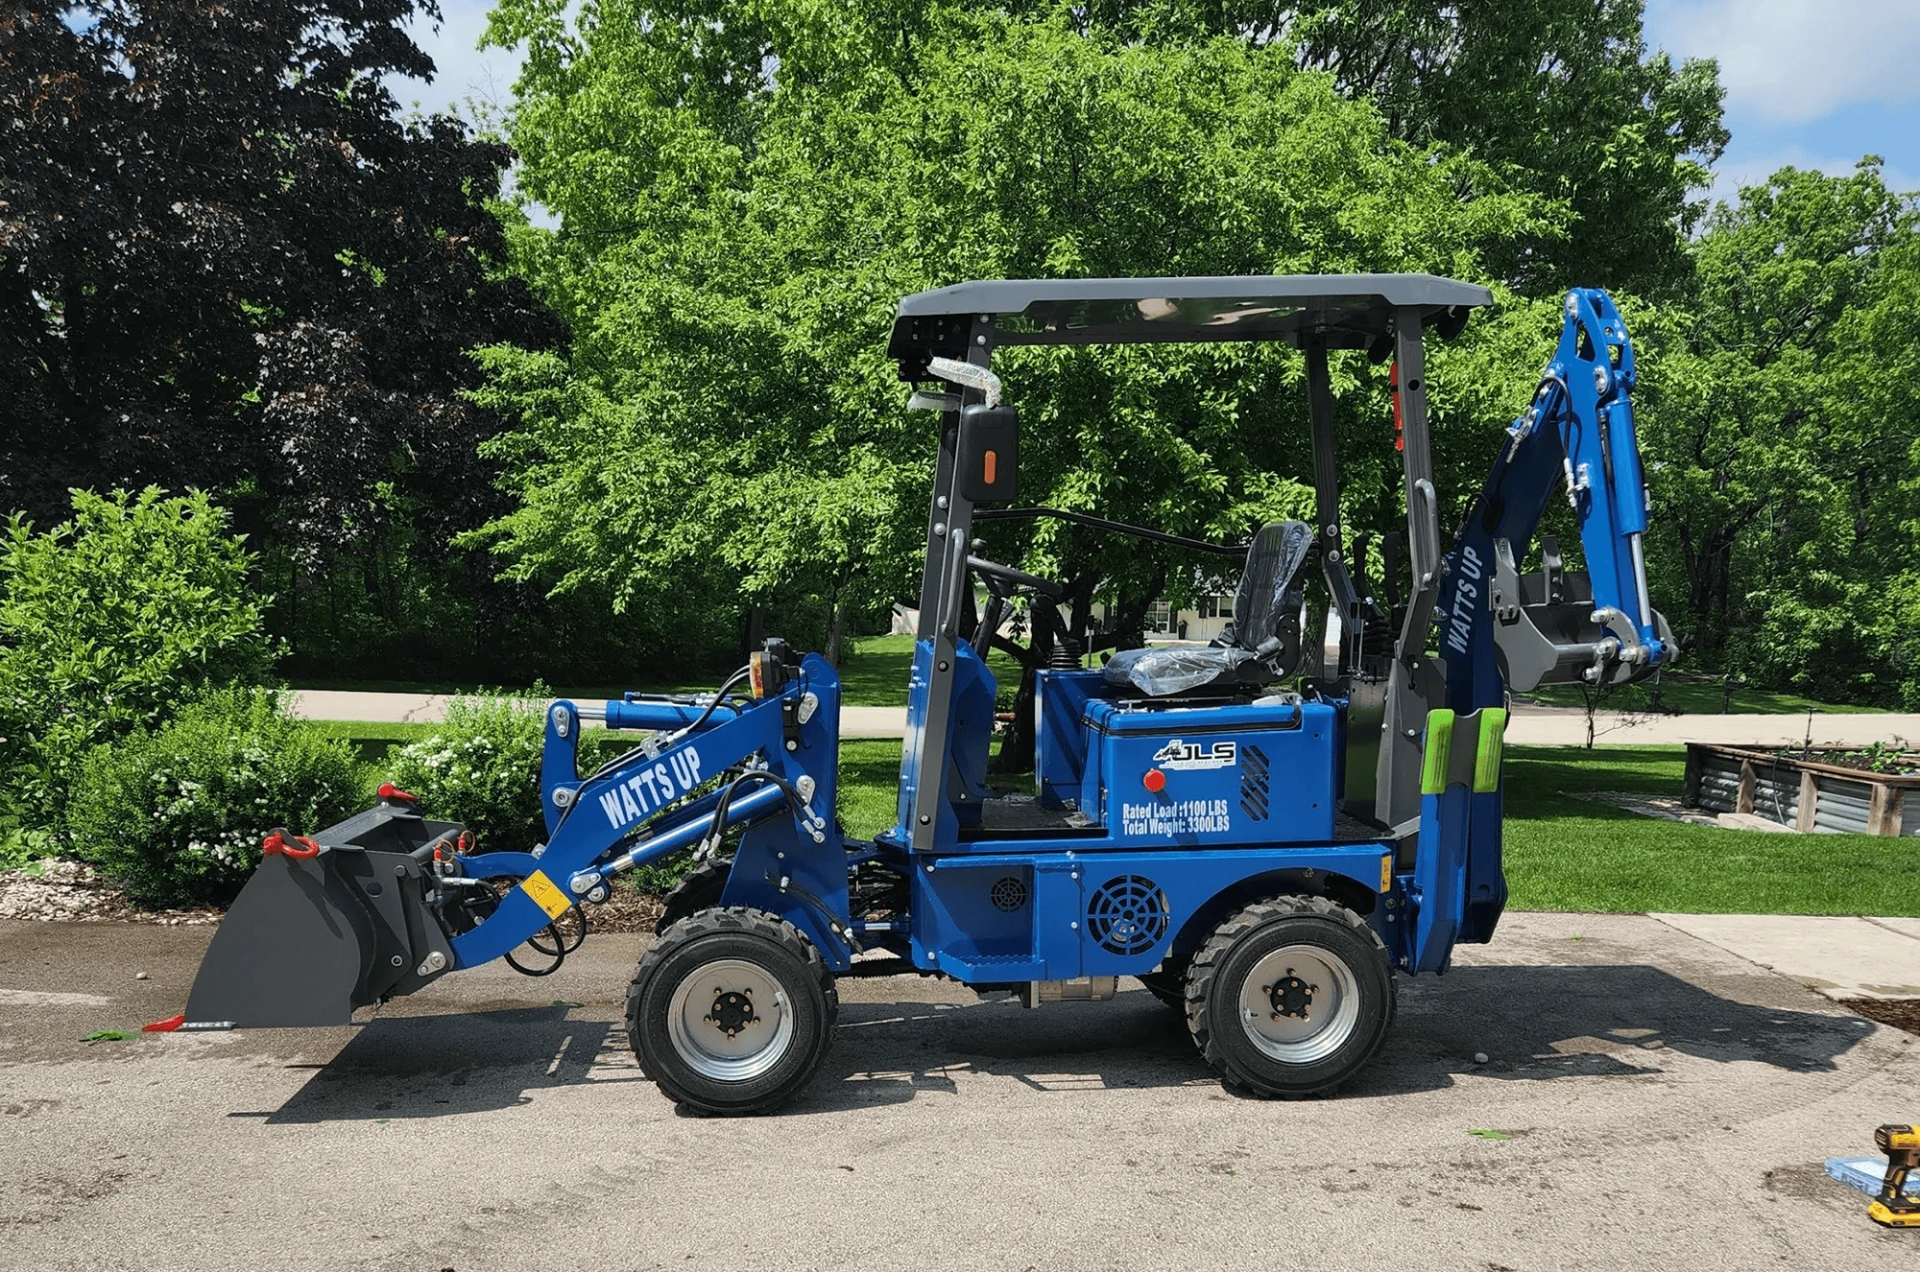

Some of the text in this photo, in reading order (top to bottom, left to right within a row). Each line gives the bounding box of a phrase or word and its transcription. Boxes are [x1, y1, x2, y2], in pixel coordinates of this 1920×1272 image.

[1447, 546, 1483, 654] WATTS UP
[599, 746, 701, 830] WATTS UP
[1123, 803, 1151, 819] Rated
[1154, 802, 1177, 818] Load
[1208, 799, 1228, 816] LBS
[1122, 819, 1147, 836] Total
[1149, 818, 1186, 838] Weight:
